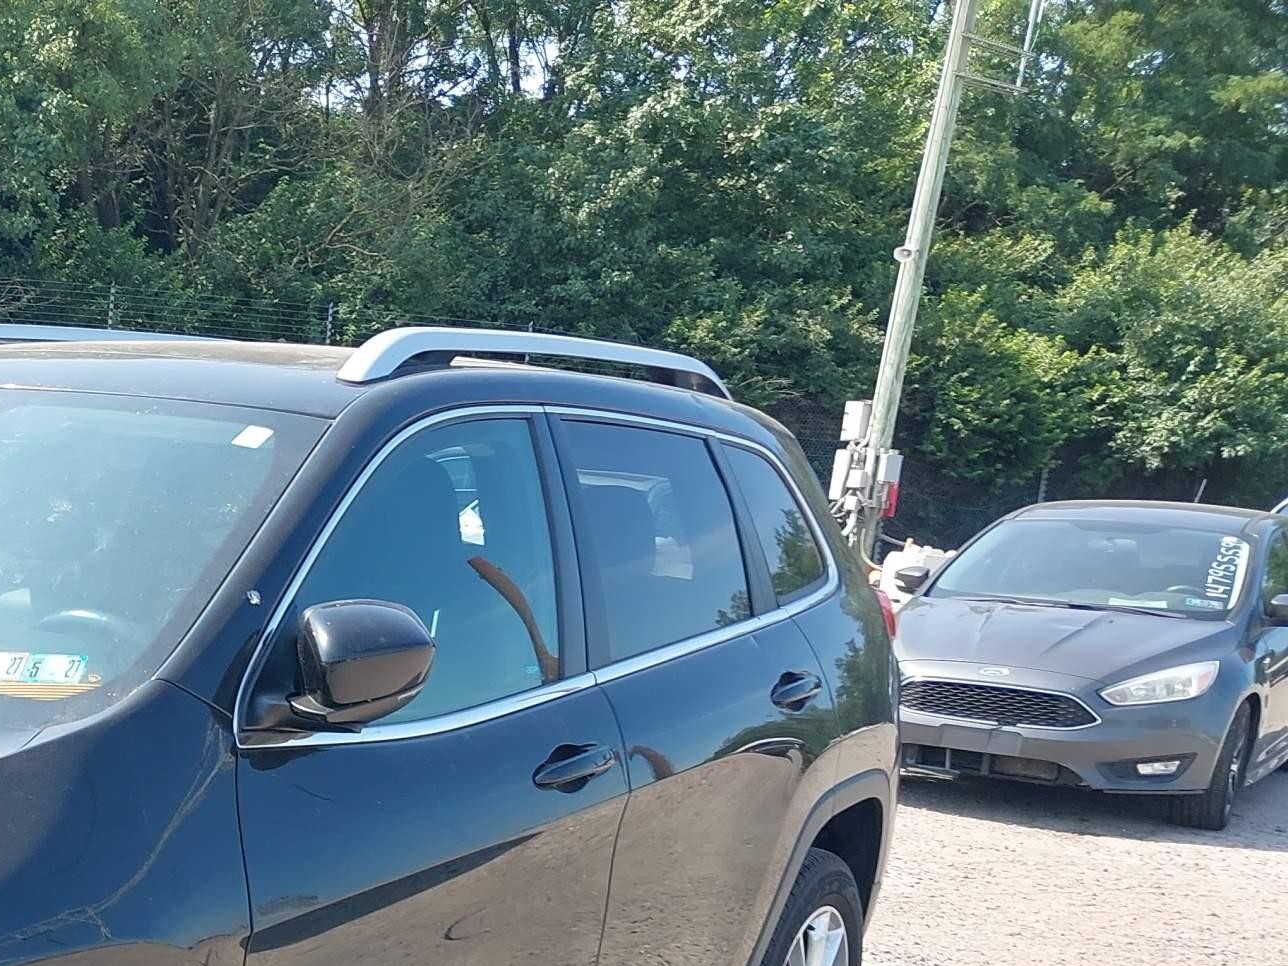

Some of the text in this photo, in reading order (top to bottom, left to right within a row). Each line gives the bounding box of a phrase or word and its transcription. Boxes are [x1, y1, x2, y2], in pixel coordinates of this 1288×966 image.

[6, 657, 23, 675] 27
[29, 659, 82, 678] 5 27
